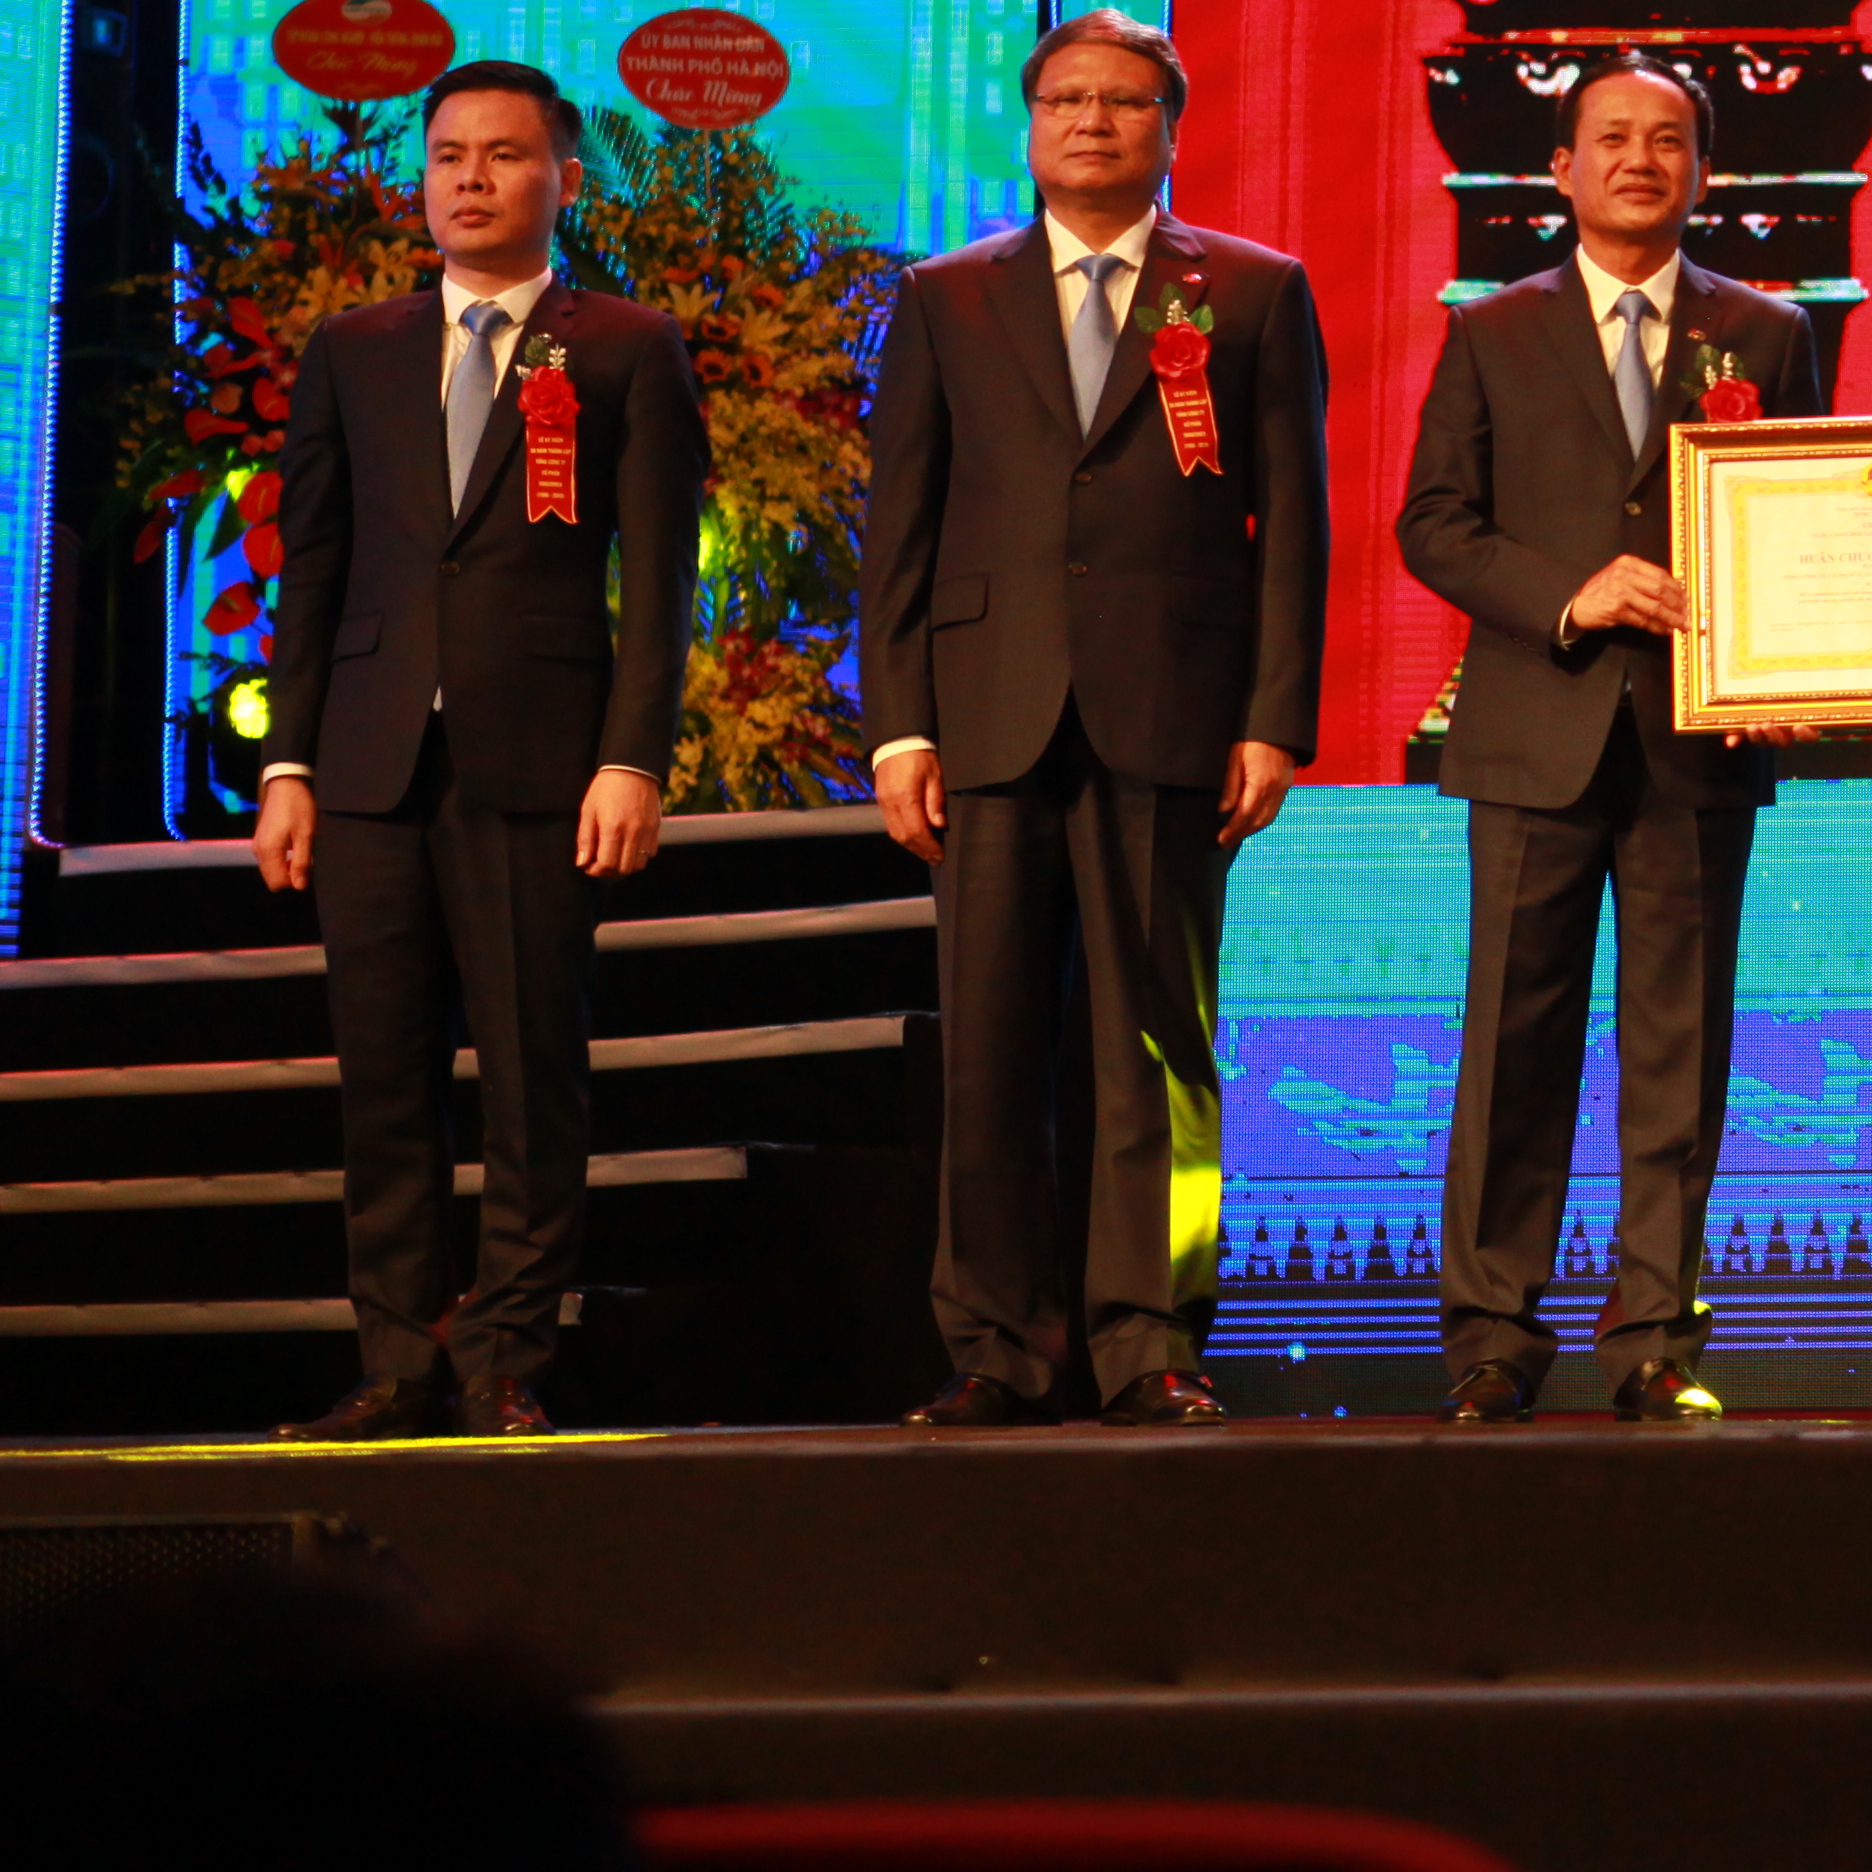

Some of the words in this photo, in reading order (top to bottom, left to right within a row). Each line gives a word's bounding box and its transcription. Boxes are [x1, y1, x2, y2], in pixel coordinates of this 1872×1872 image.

[662, 33, 691, 49] BAN
[693, 33, 733, 51] NHÂN
[626, 54, 684, 72] THÀNH
[688, 56, 723, 74] PHỐ
[727, 58, 750, 76] HÀ
[752, 58, 784, 80] NỘI
[1800, 551, 1835, 564] HUÂN
